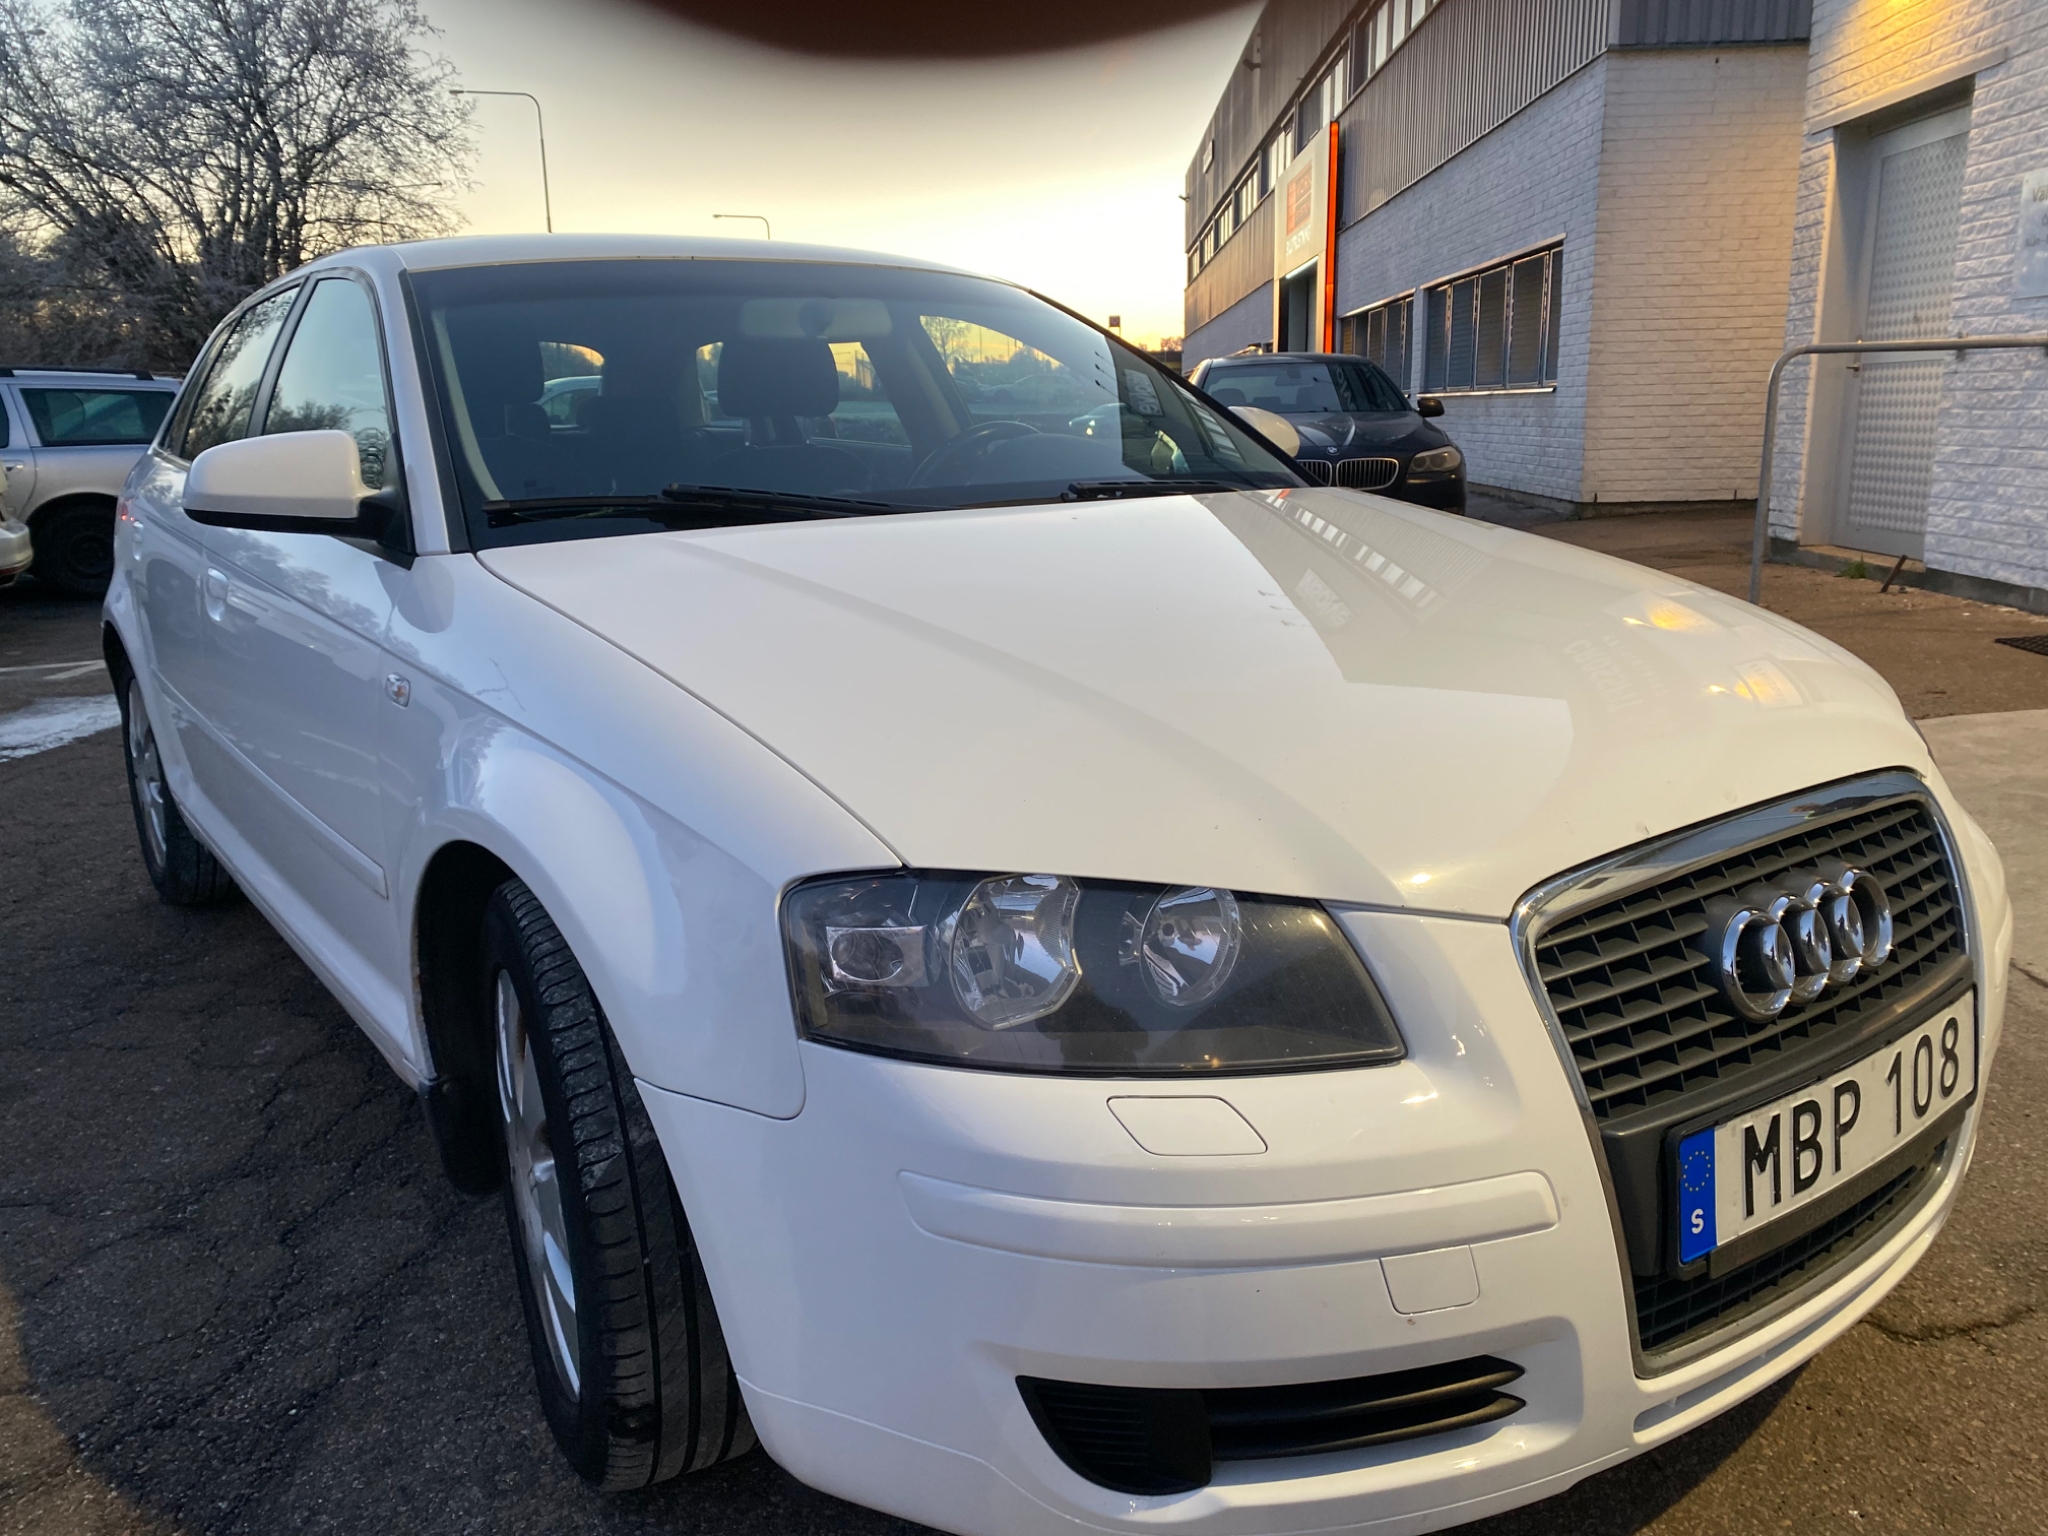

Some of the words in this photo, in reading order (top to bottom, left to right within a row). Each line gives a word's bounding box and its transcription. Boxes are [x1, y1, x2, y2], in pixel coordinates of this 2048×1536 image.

[1743, 1079, 1861, 1219] MBP
[1885, 1017, 1960, 1136] 108
[1690, 1208, 1704, 1234] S
